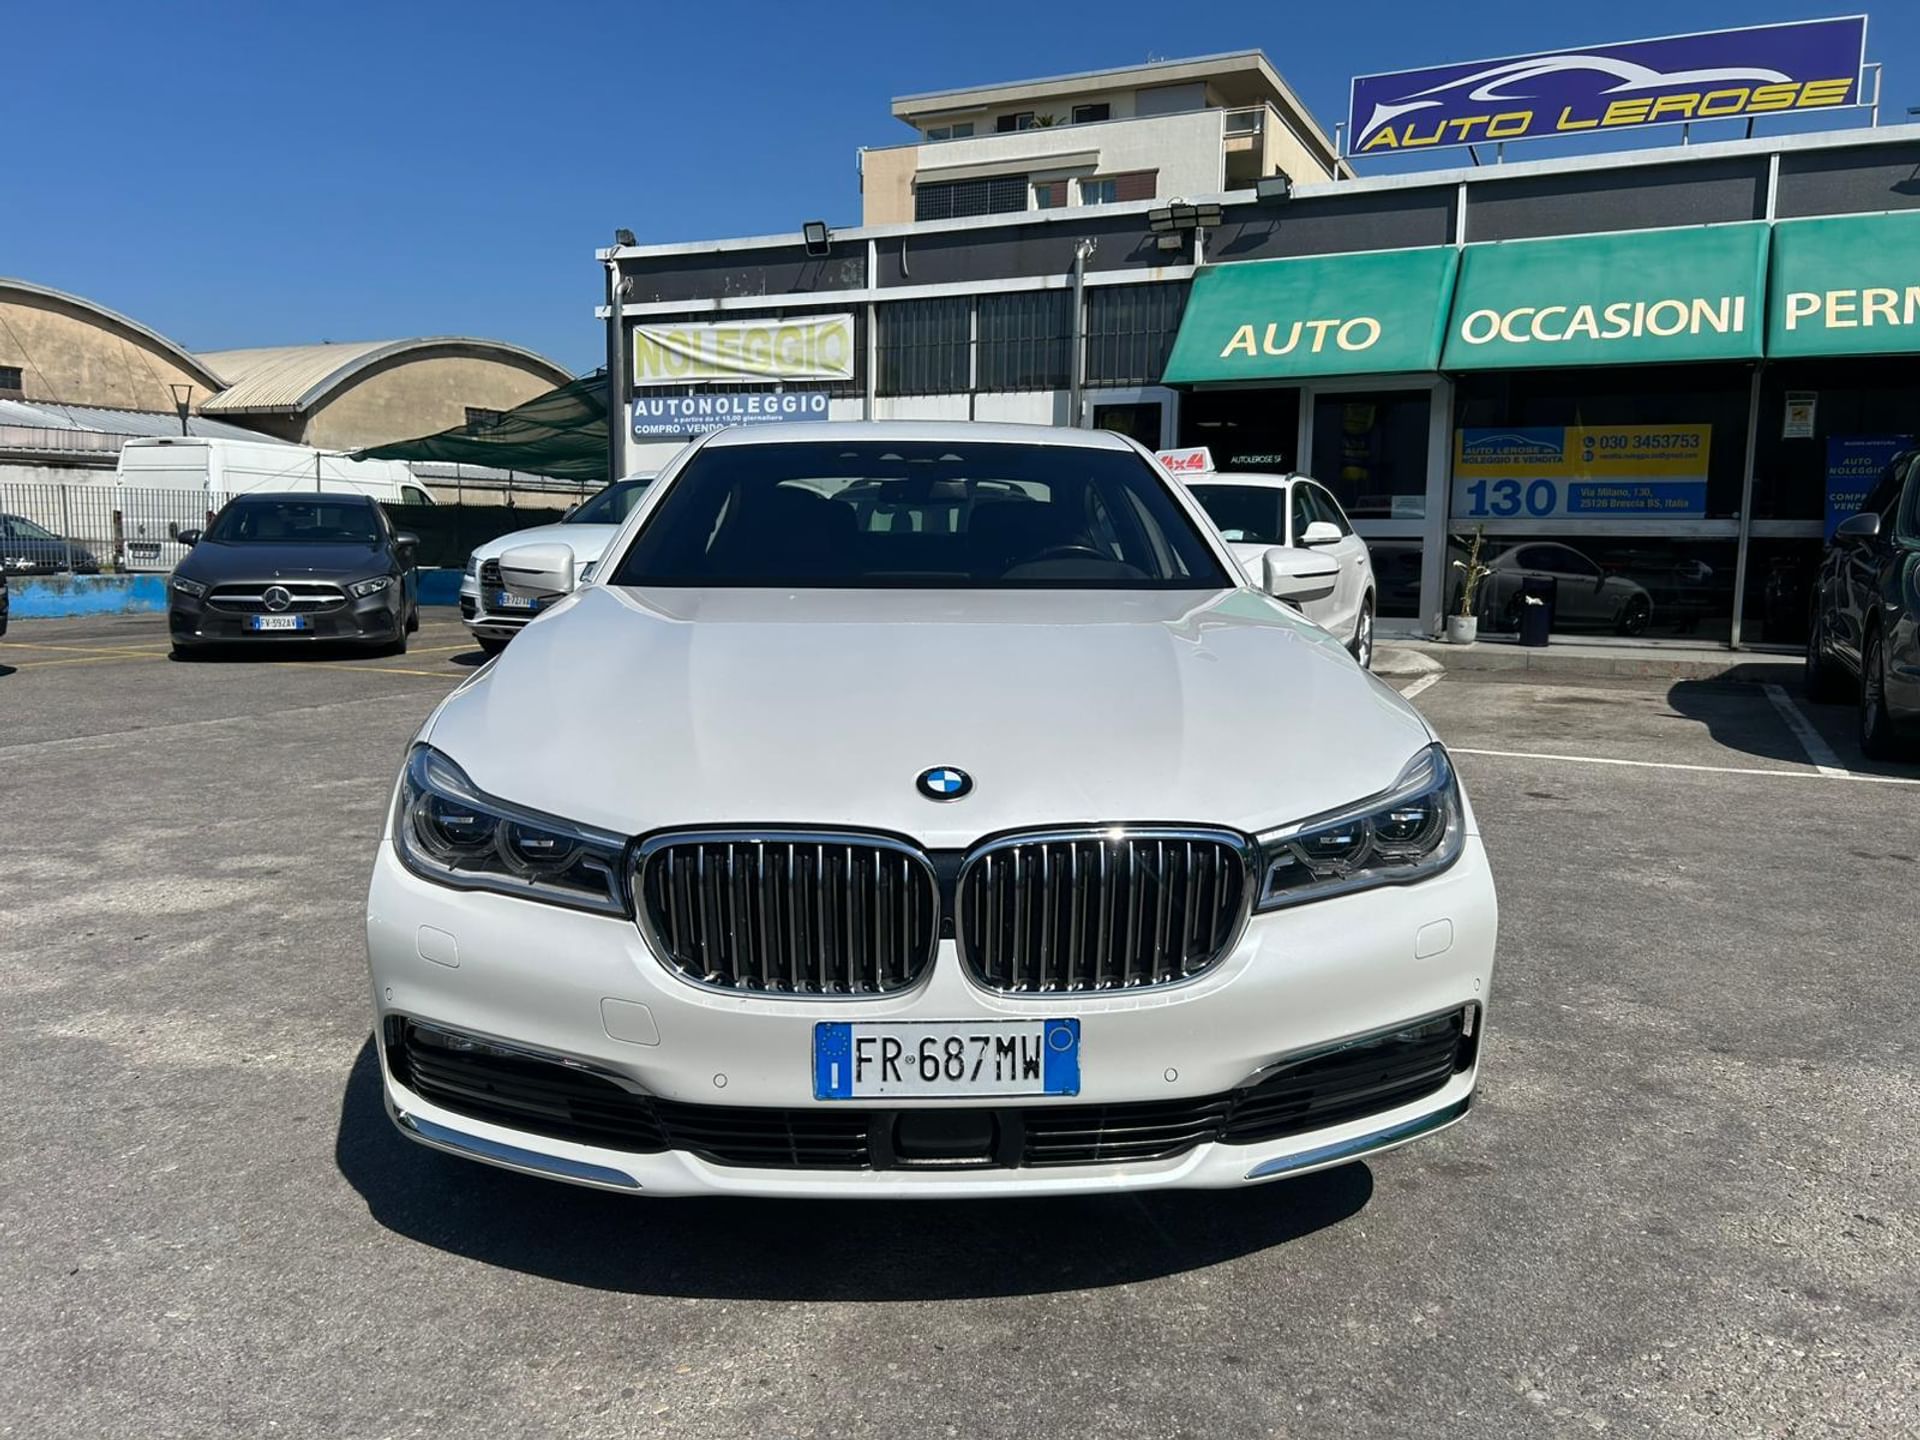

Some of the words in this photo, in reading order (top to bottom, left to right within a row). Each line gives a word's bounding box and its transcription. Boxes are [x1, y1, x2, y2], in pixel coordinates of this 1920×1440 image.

[1361, 110, 1534, 151] AUTO
[1556, 78, 1854, 131] LEROSE
[1220, 316, 1382, 358] AUTO
[1460, 296, 1746, 345] OCCASIONI
[636, 322, 849, 377] NOLEGGIO
[634, 395, 827, 416] AUTONOLEGGIO
[1600, 435, 1628, 448] 030
[1632, 434, 1700, 448] 3453753
[1521, 455, 1563, 463] VENDITA
[1842, 457, 1872, 465] AUTO
[1467, 479, 1557, 516] 130
[1580, 487, 1595, 496] Via
